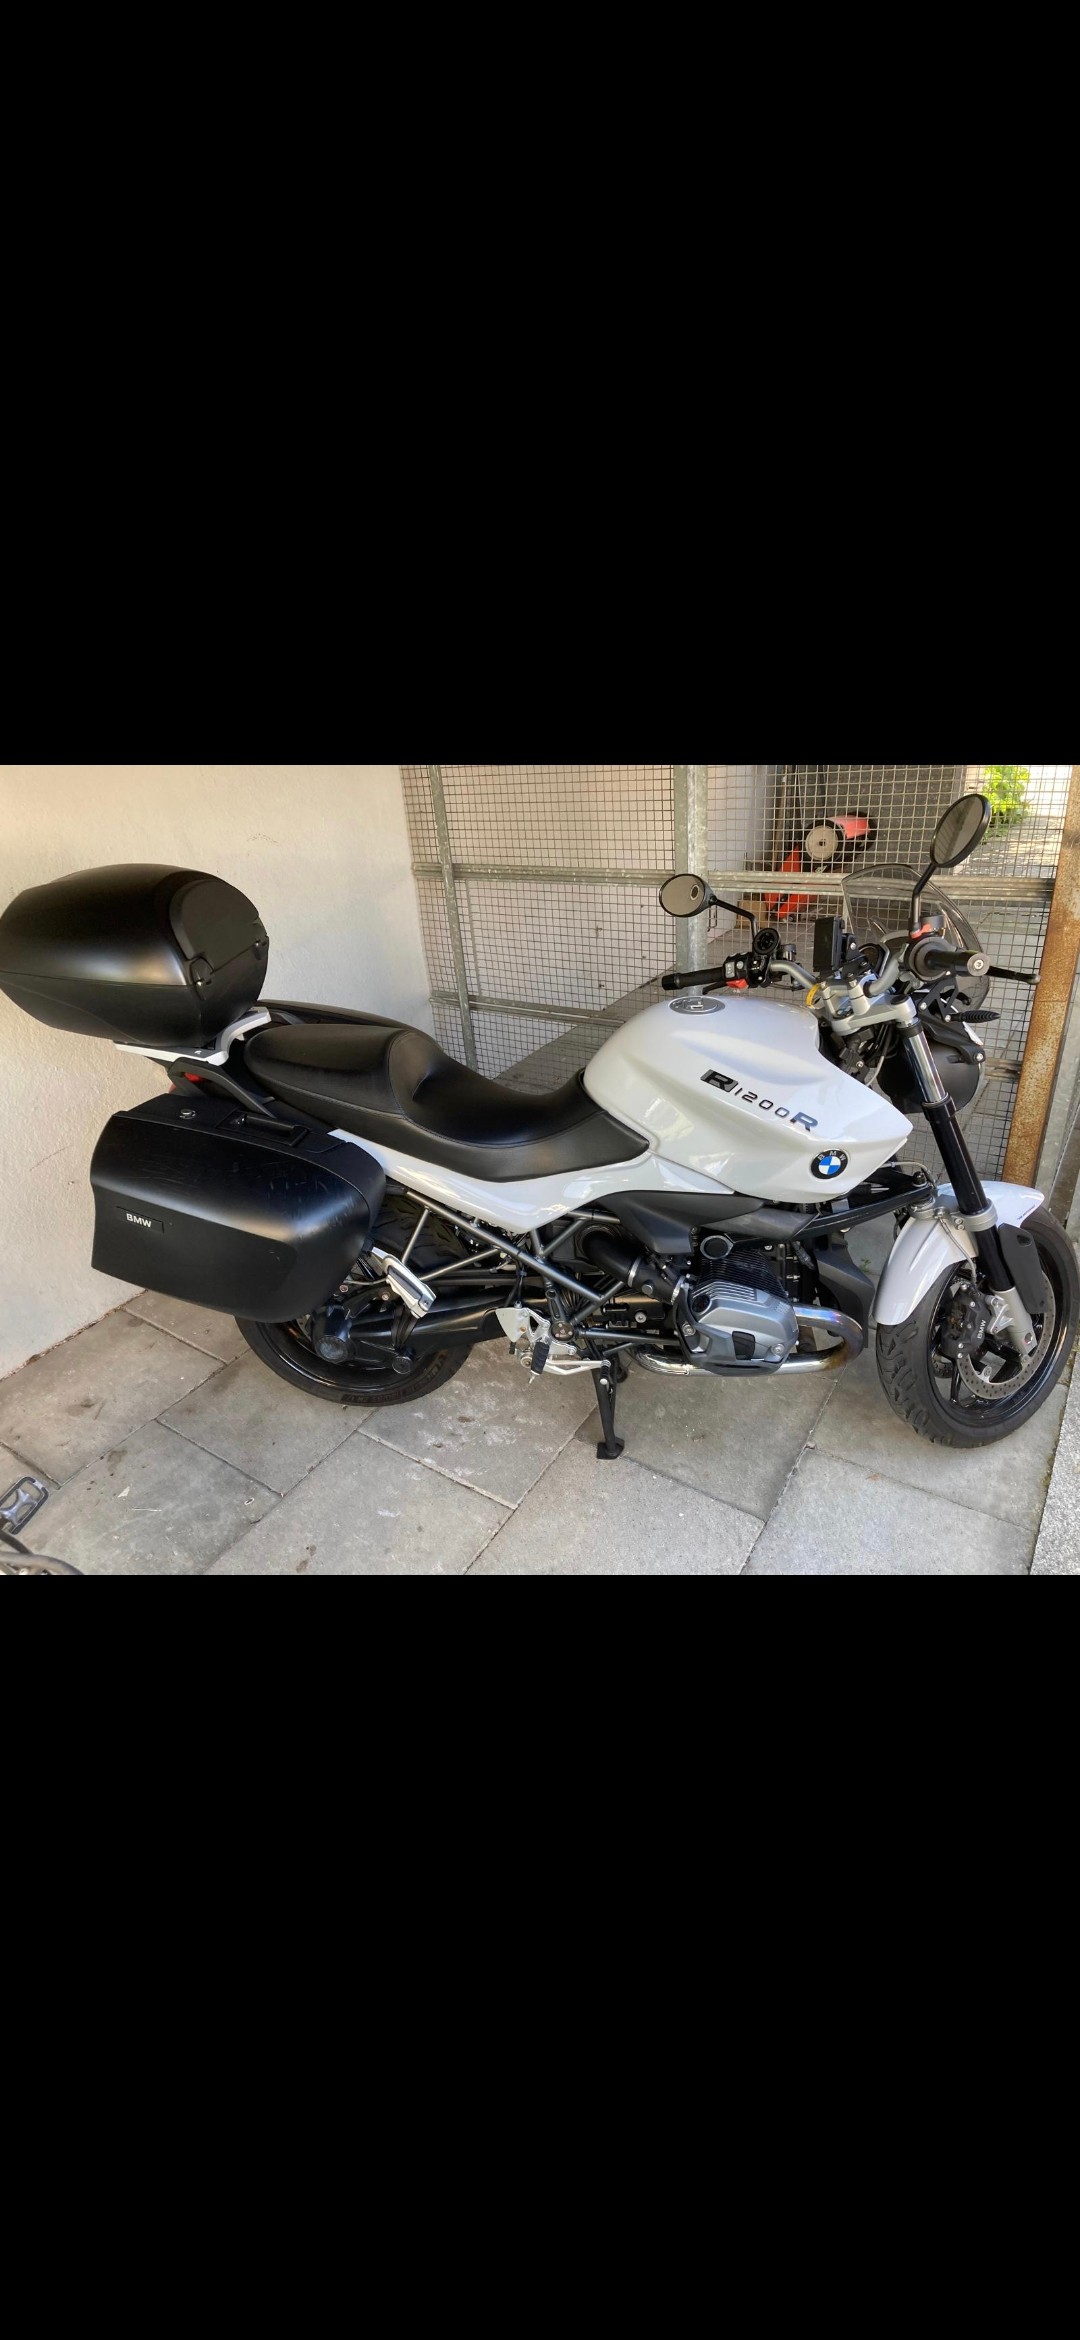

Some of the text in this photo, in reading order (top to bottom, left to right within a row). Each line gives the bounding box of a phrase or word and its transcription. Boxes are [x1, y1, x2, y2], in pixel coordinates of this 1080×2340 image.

[817, 1150, 847, 1161] BMW
[126, 1213, 152, 1228] BMW
[977, 1319, 987, 1339] BMW
